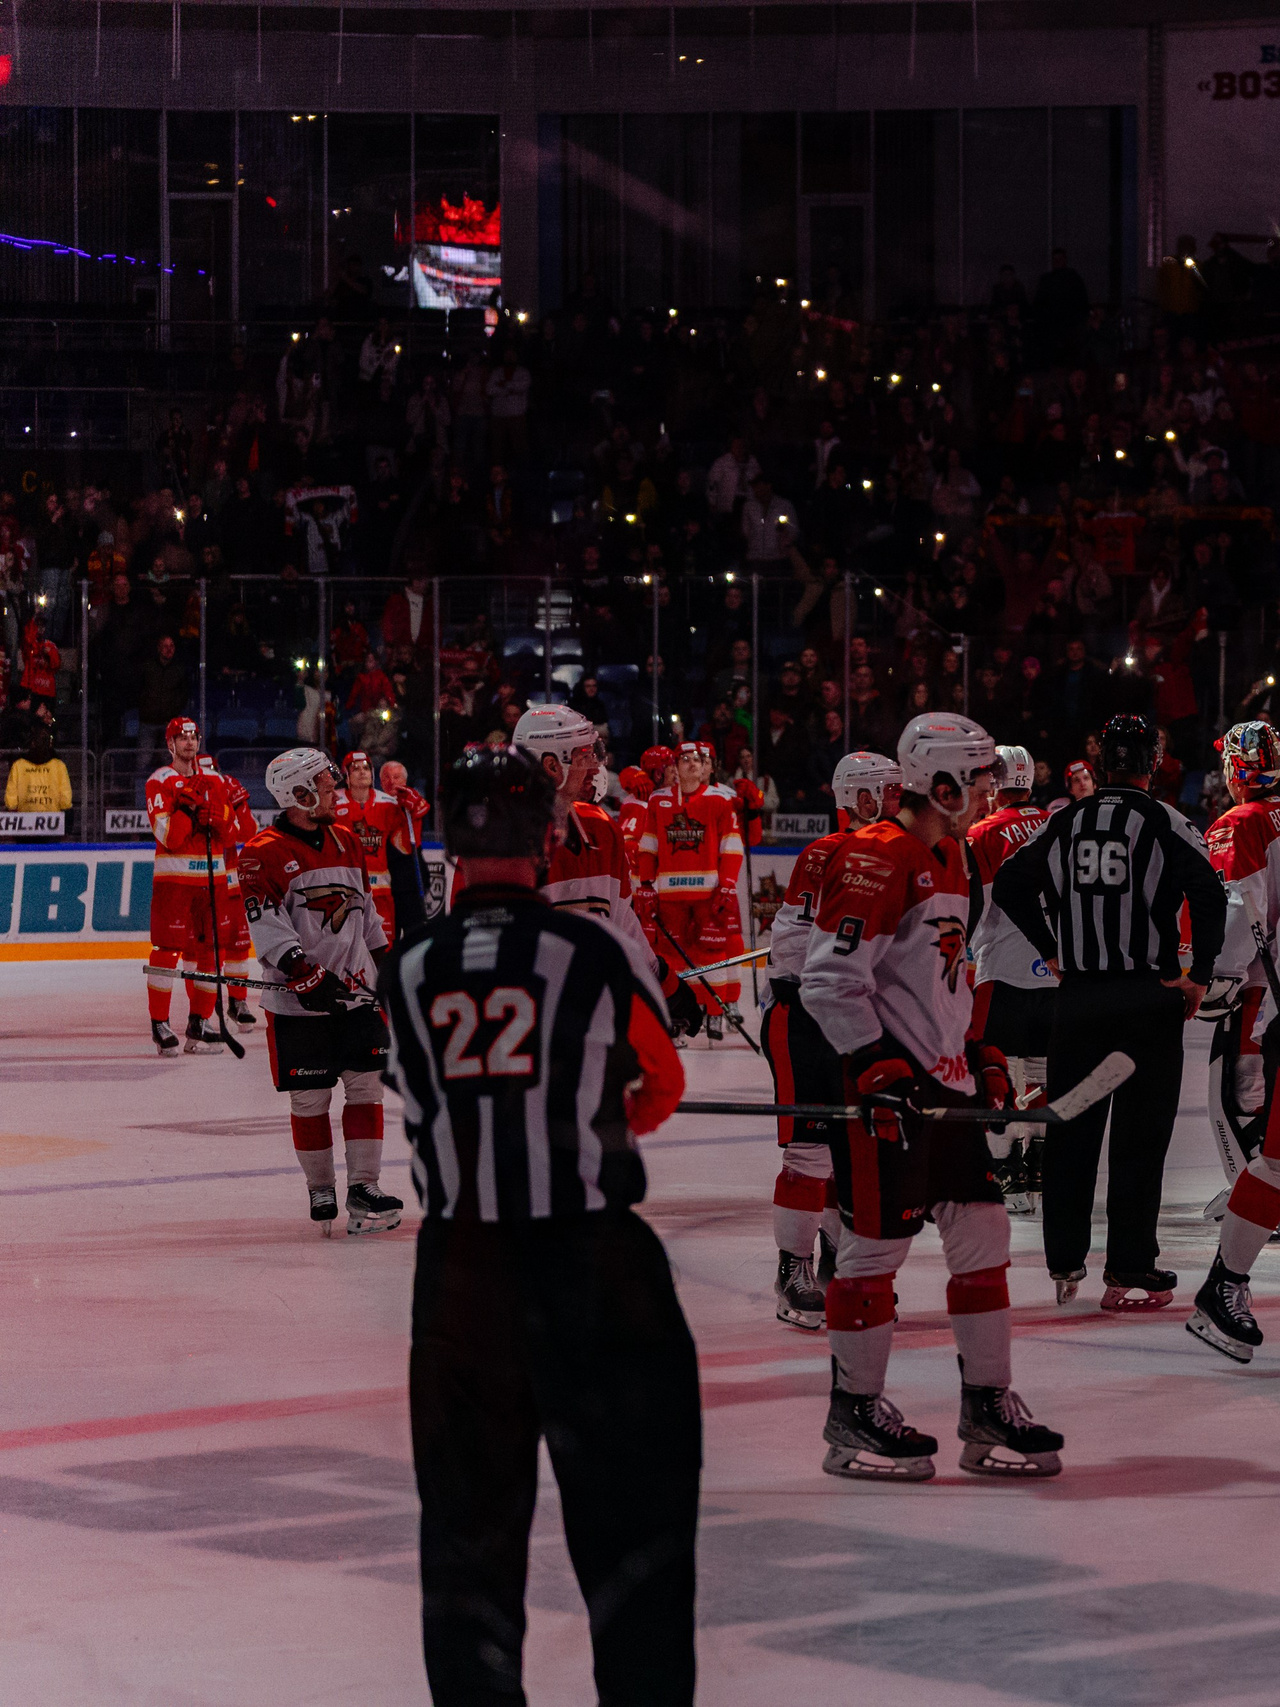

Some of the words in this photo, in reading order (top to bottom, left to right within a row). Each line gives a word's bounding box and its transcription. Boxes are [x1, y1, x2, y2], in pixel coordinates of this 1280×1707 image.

[1014, 775, 1027, 787] 65
[0, 815, 60, 831] HL.RU
[110, 814, 150, 829] KHL.
[775, 816, 826, 834] KHL.RU
[1076, 839, 1128, 886] 96
[669, 877, 705, 886] SIBUR
[841, 872, 886, 891] G-DRIVE
[244, 895, 280, 923] 84
[832, 915, 866, 957] 9
[294, 966, 326, 993] CCM
[289, 1067, 328, 1077] G-ENERGY
